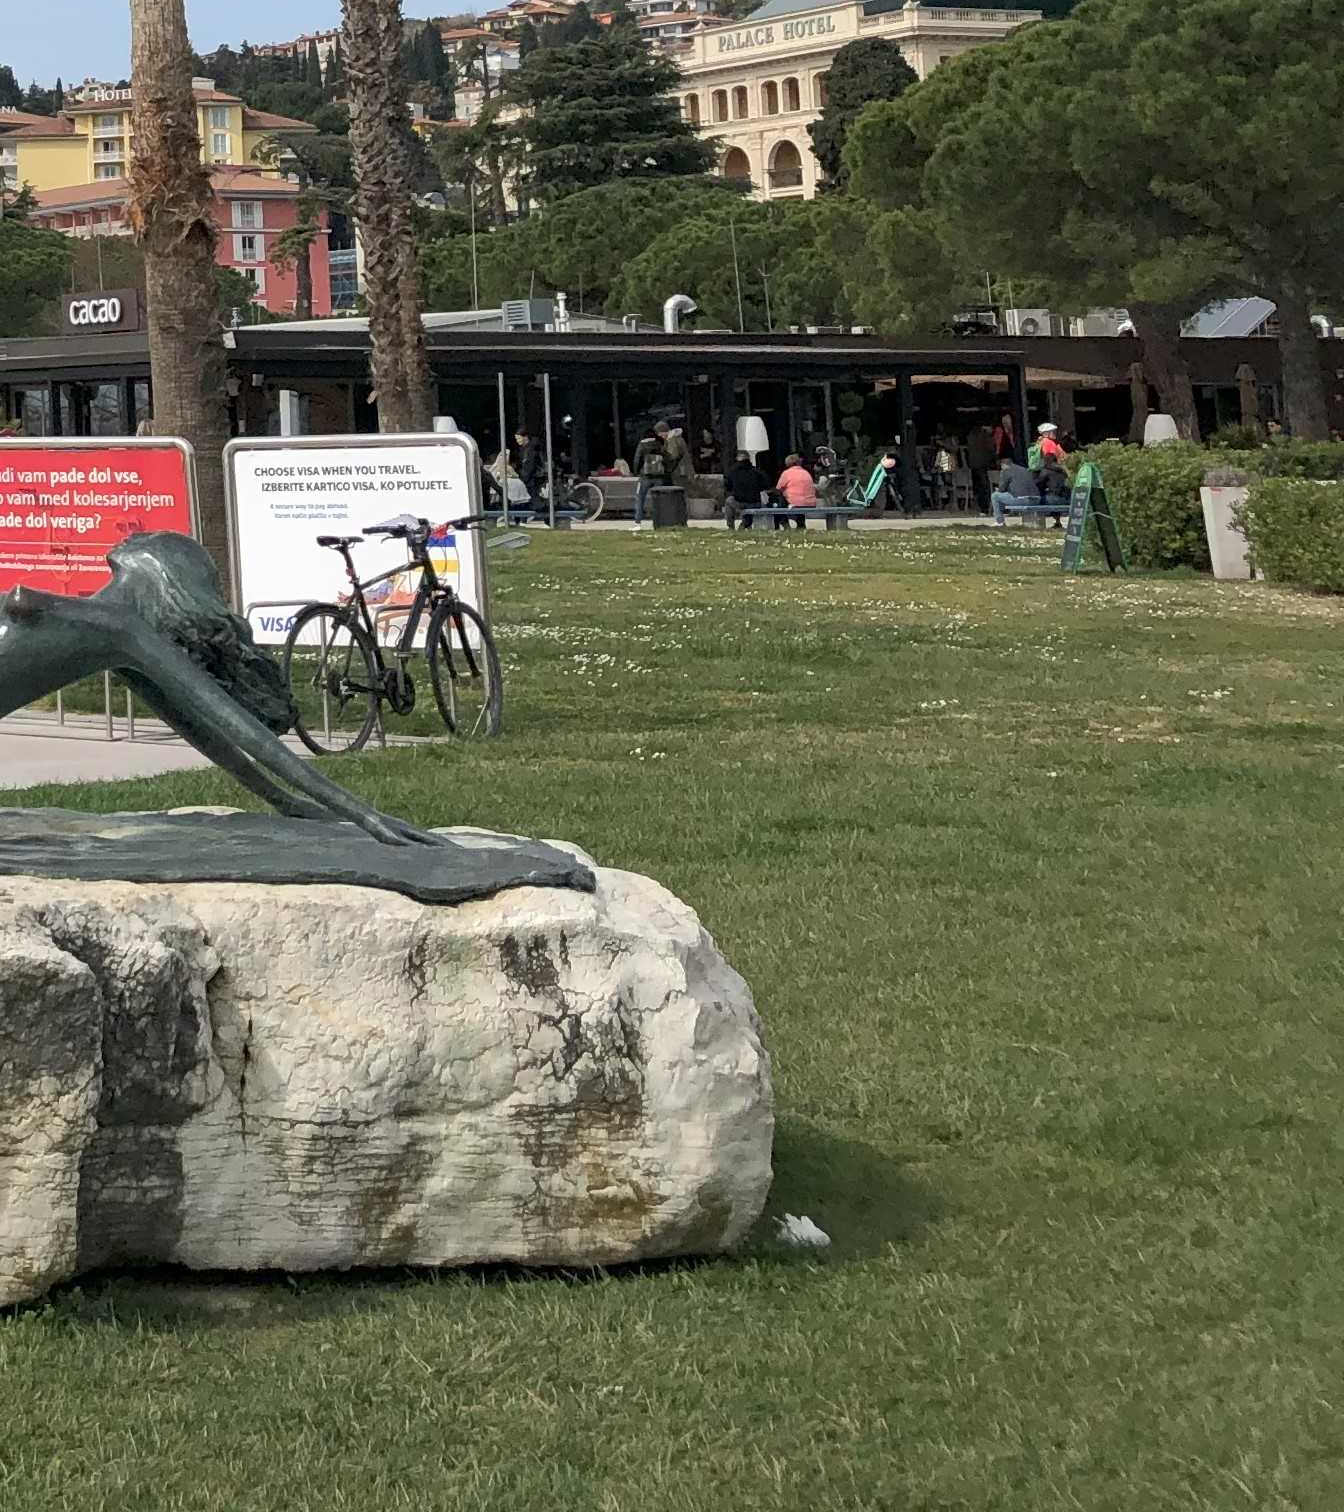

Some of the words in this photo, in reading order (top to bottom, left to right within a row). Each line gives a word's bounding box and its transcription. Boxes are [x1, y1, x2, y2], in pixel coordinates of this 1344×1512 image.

[719, 27, 774, 52] PALACE
[783, 15, 836, 40] HOTEL
[69, 298, 121, 325] cacao
[17, 471, 47, 483] vam
[50, 468, 85, 487] pade
[88, 468, 111, 484] dol
[114, 470, 143, 486] vse,
[254, 467, 295, 477] CHOOSE
[297, 467, 320, 476] VISA
[321, 466, 353, 476] WHEN
[354, 465, 376, 475] YOU
[378, 464, 421, 475] TRAVEL.
[261, 482, 305, 492] IZBERITE
[306, 481, 351, 491] KARTICO
[352, 481, 378, 491] VISA,
[380, 480, 395, 491] KO
[396, 480, 453, 491] POTUJETE.
[6, 493, 36, 506] vam
[39, 490, 70, 507] med
[73, 489, 174, 511] kolesarjenjem
[25, 512, 48, 528] dol
[50, 513, 102, 533] veriga?
[258, 616, 297, 633] VISA
